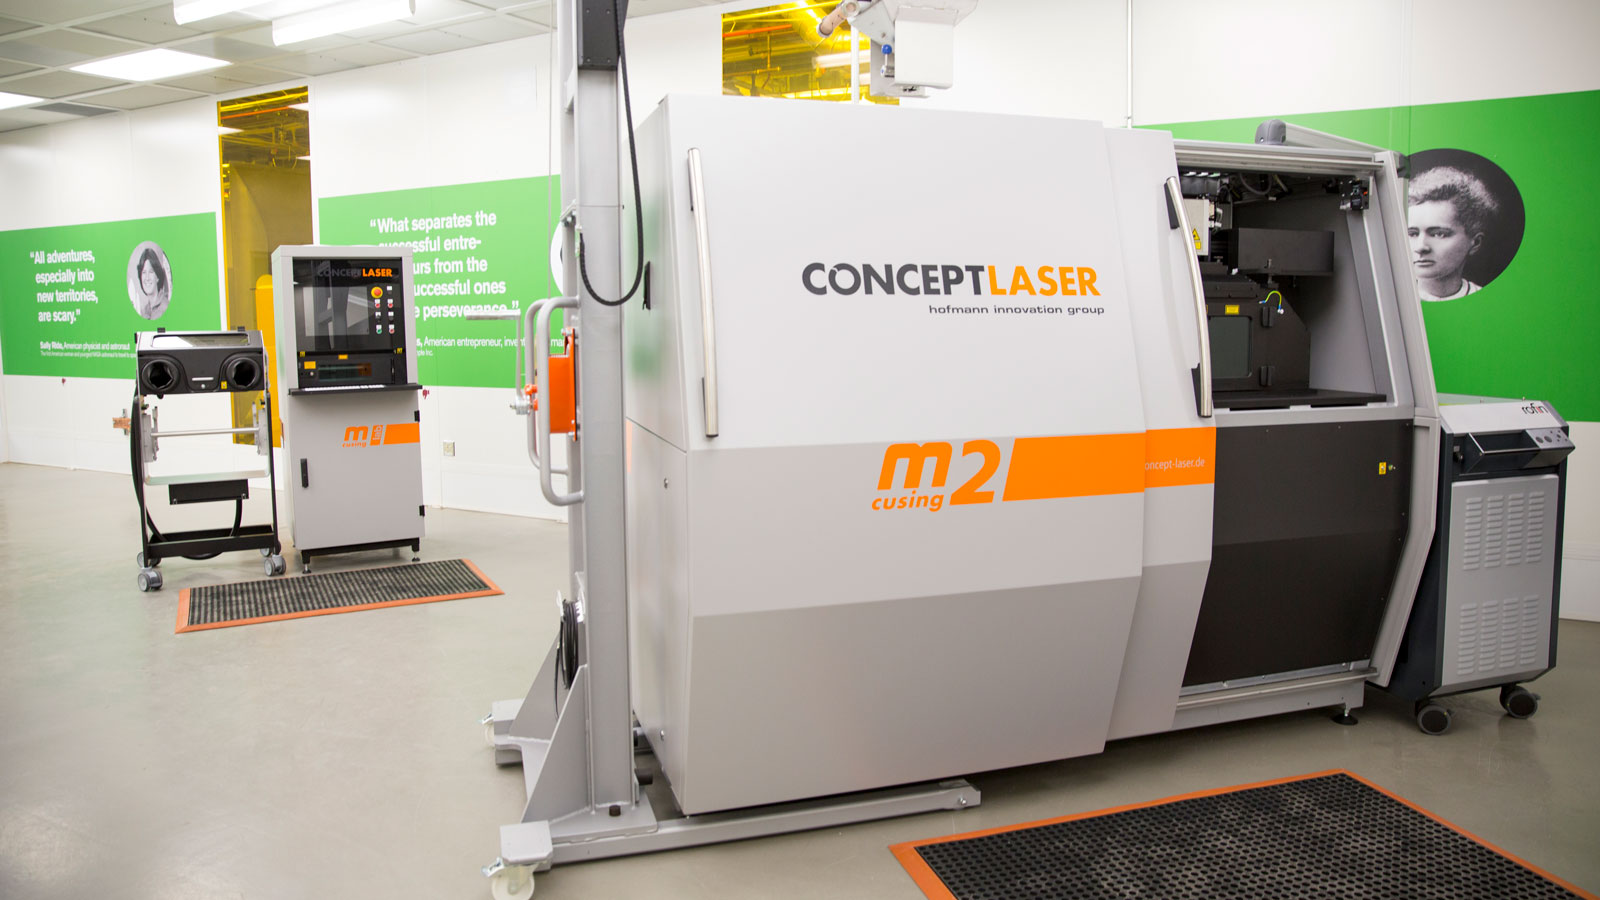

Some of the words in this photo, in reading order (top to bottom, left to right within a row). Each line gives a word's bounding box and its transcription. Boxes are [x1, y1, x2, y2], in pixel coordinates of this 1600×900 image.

[411, 212, 473, 233] separates
[475, 210, 497, 226] the
[443, 234, 481, 250] entre-
[46, 249, 95, 264] adventures,
[433, 258, 465, 274] from
[466, 256, 488, 272] the
[35, 268, 76, 286] especially
[77, 268, 95, 281] into
[414, 279, 471, 296] uccessful
[473, 281, 506, 295] ones
[37, 291, 54, 303] new
[55, 288, 98, 304] territories,
[38, 311, 51, 322] are
[928, 304, 989, 315] hofmann
[993, 304, 1063, 315] innovation
[1066, 306, 1105, 316] group
[424, 336, 456, 347] American
[456, 337, 503, 349] entrepreneur,
[1521, 403, 1549, 415] rofin
[1144, 457, 1205, 471] oncept-laser.de
[871, 489, 945, 512] cusing
